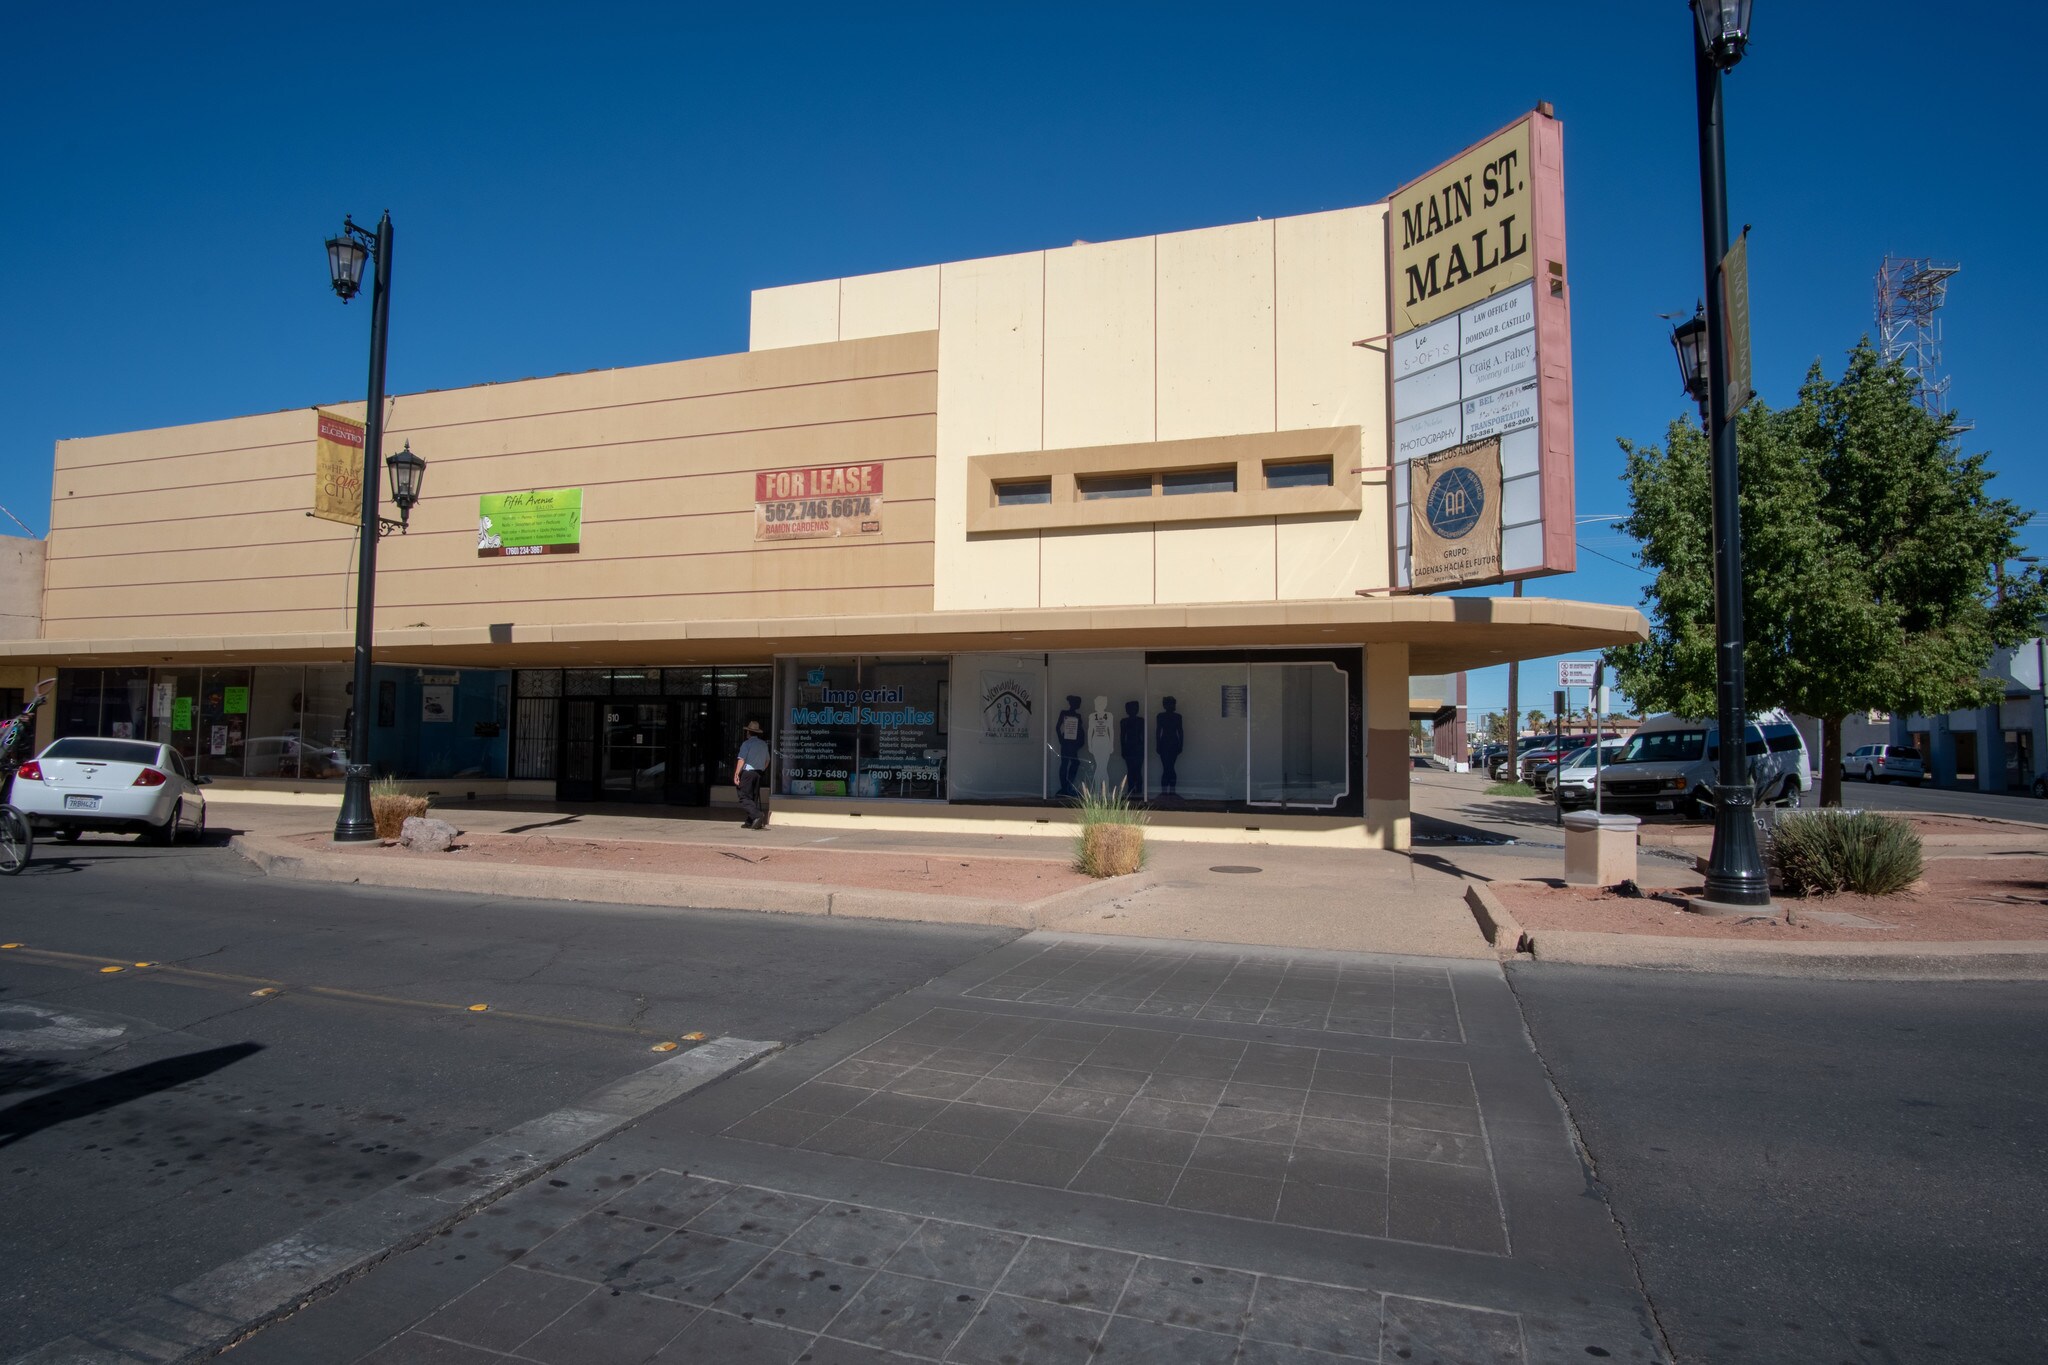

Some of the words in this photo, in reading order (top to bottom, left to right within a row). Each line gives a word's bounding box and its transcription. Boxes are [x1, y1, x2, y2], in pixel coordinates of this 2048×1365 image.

[1402, 174, 1472, 250] MAIN
[1483, 150, 1523, 209] ST.
[1405, 214, 1527, 307] MALL
[1473, 310, 1487, 323] LAW
[1487, 303, 1508, 319] OFFICE
[1509, 298, 1518, 311] OF
[1465, 328, 1493, 345] DOMINGO
[1494, 324, 1501, 334] R.
[1501, 312, 1531, 331] CASTILLO
[1415, 336, 1427, 350] Lee
[1469, 358, 1491, 374] Craig
[1493, 356, 1502, 366] A.
[1505, 345, 1532, 362] Fahey
[1511, 361, 1526, 372] Law
[1479, 396, 1495, 407] BEL
[1470, 407, 1530, 432] TRANSPORTATION
[1400, 427, 1457, 452] PHOTOGRAPHY
[331, 464, 359, 478] HEART
[336, 475, 359, 489] OUR
[765, 472, 805, 498] FOR
[810, 466, 872, 495] LEASE
[324, 483, 357, 501] CITY
[504, 494, 523, 509] Fifth
[526, 495, 554, 506] Avenue
[1428, 481, 1441, 507] UNIDAD
[765, 497, 871, 523] 562.746.6674
[1445, 489, 1465, 517] AA
[765, 523, 790, 534] RAMON
[791, 521, 829, 533] CARDENAS
[1443, 547, 1469, 559] GRUPO:
[1414, 565, 1443, 577] CADENAS
[1444, 560, 1464, 572] HACIA
[1466, 558, 1473, 568] EL
[607, 713, 620, 723] 510
[791, 706, 858, 725] Medical
[860, 706, 934, 730] Supplies
[781, 767, 804, 778] (760)
[807, 769, 848, 780] 337-6480
[868, 770, 892, 781] (800)
[896, 770, 939, 781] 950-5678
